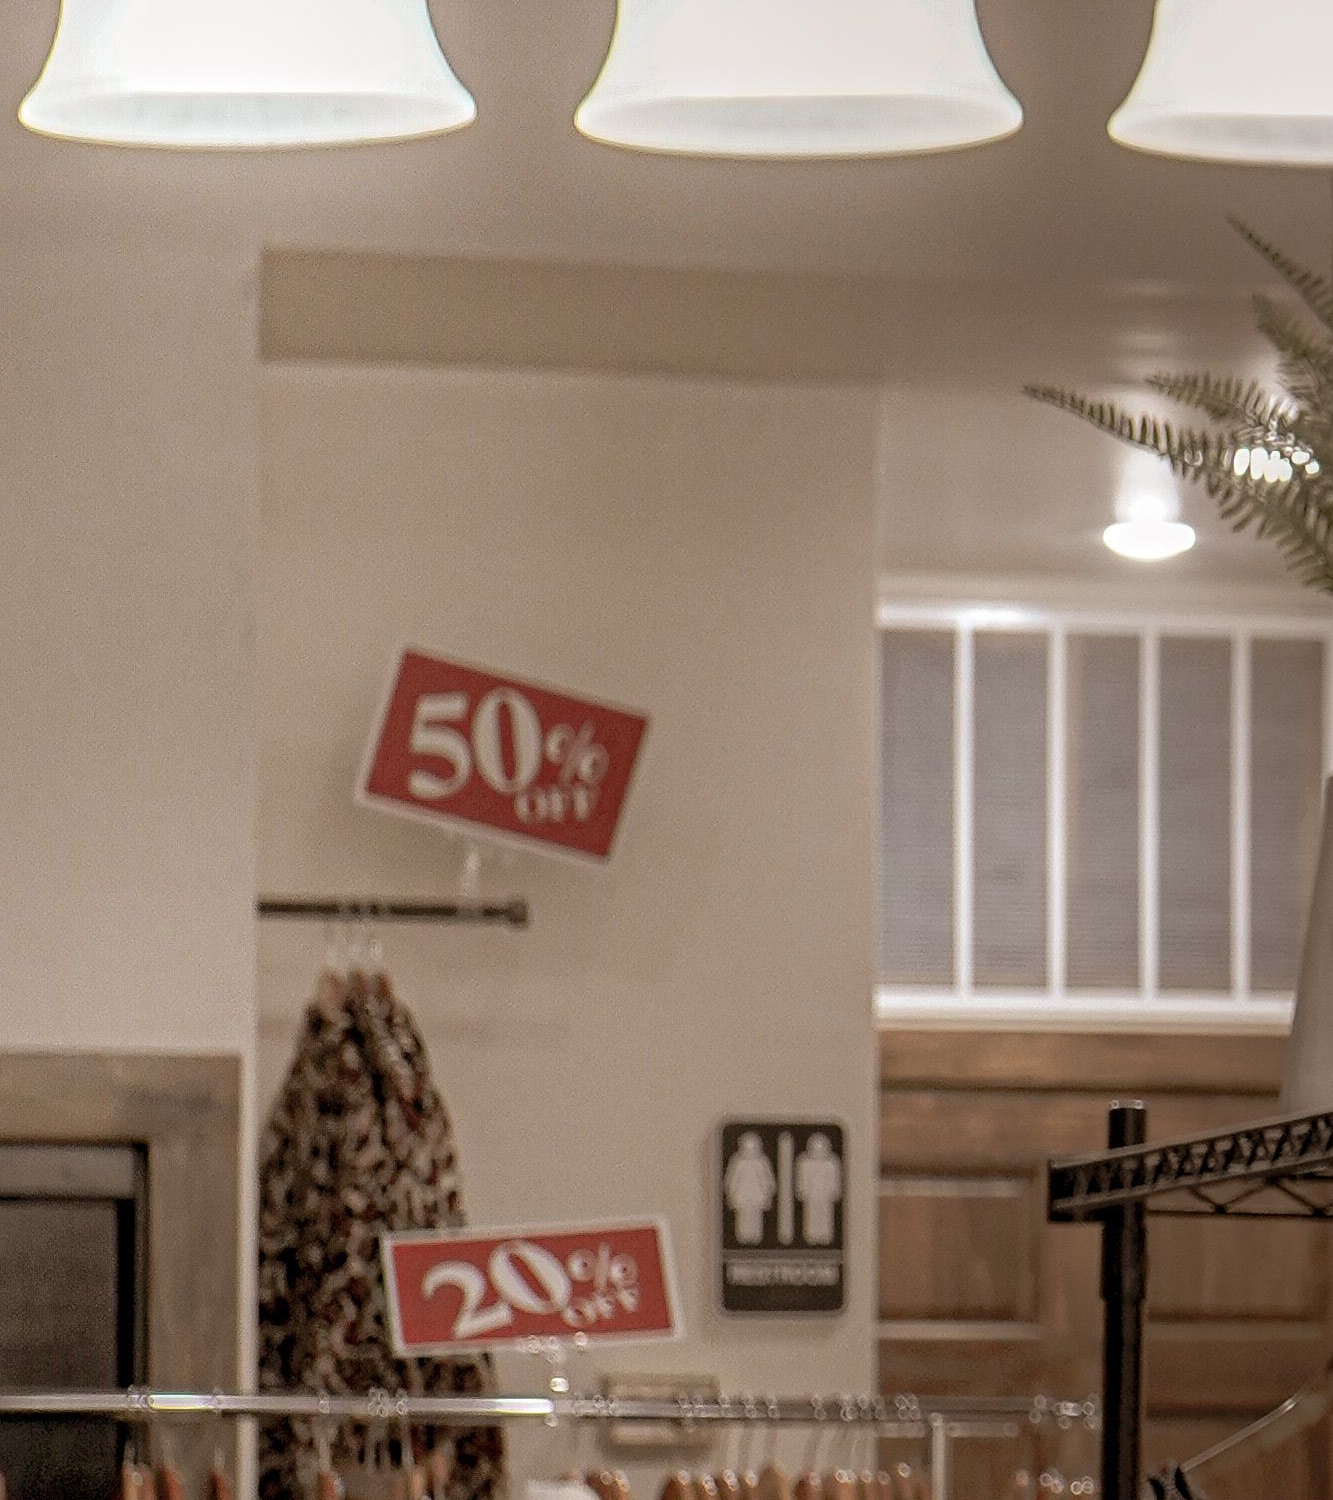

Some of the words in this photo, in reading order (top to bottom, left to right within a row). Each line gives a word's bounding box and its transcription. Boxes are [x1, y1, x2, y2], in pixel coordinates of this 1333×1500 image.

[408, 686, 609, 800] 50%
[513, 784, 599, 824] OFF
[421, 1238, 639, 1339] 20%
